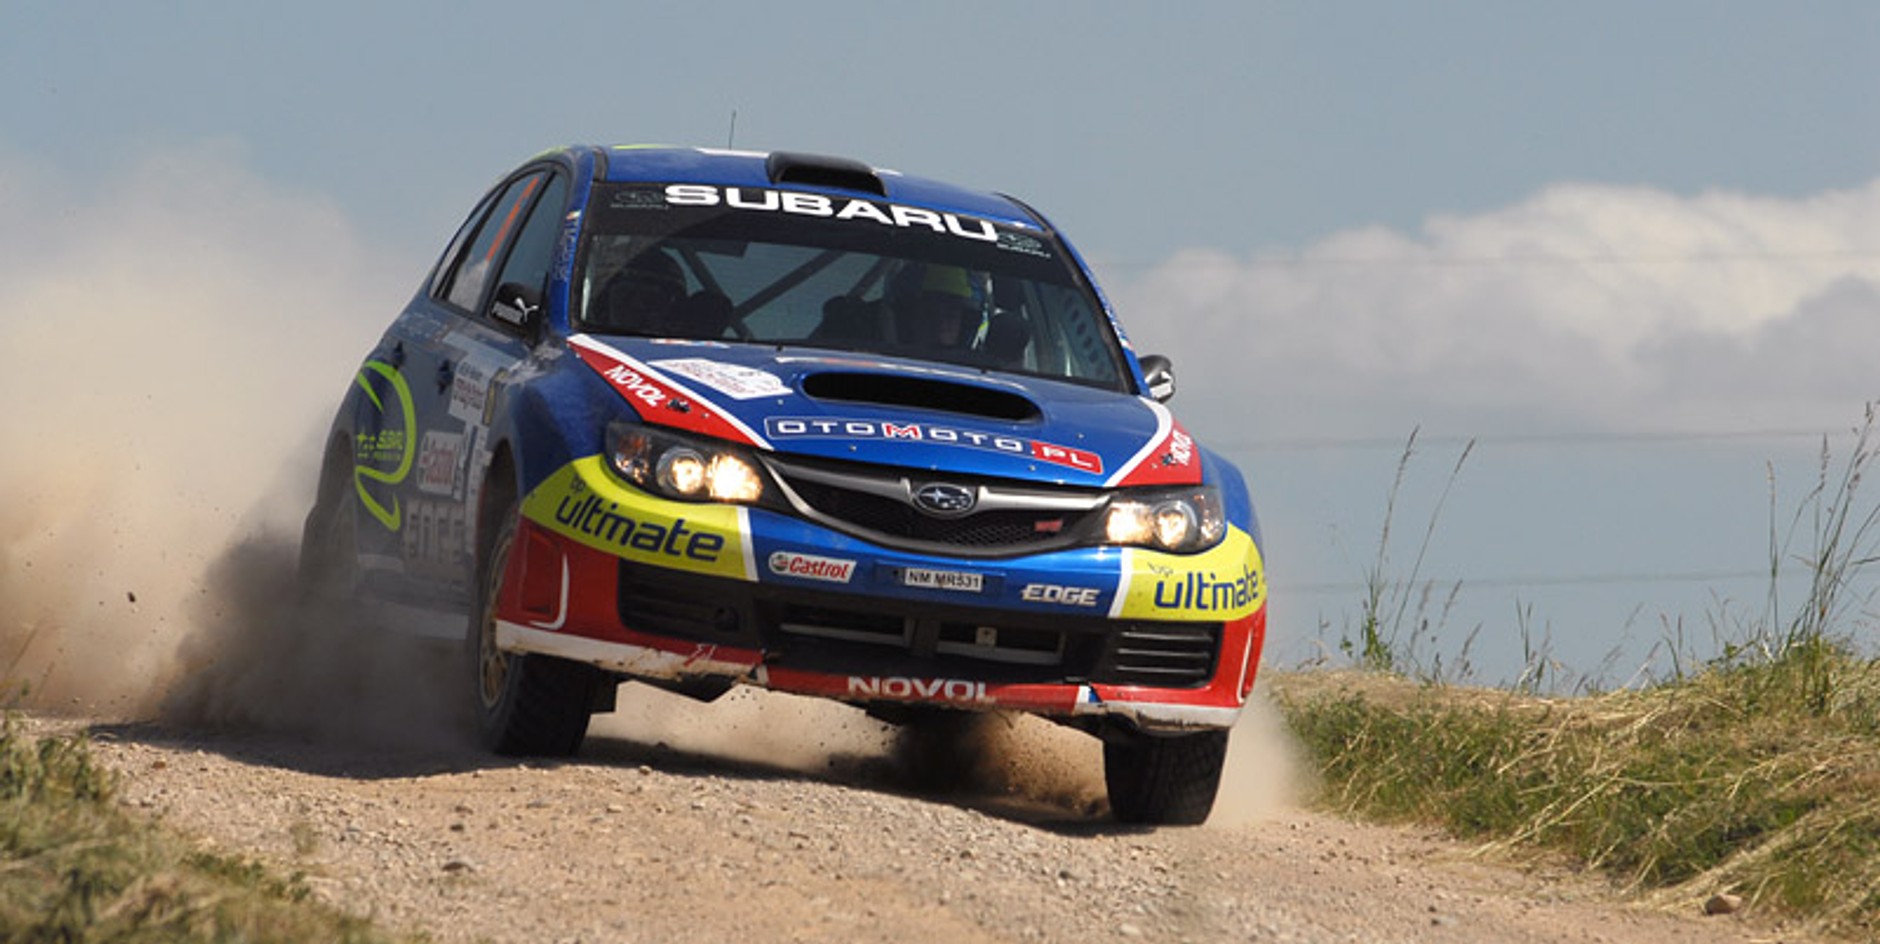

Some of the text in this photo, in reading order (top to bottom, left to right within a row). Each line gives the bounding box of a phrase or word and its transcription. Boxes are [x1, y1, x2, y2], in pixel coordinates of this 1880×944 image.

[665, 184, 998, 242] SUBARU
[604, 365, 667, 407] NOVOL
[777, 418, 1093, 469] OTOMOTO.PL
[555, 494, 725, 562] ultimate
[788, 555, 851, 580] Castrol
[908, 568, 981, 588] NM MR531
[1154, 563, 1258, 610] ultimate
[1022, 583, 1100, 606] EDGE
[848, 676, 990, 701] NOVOL
